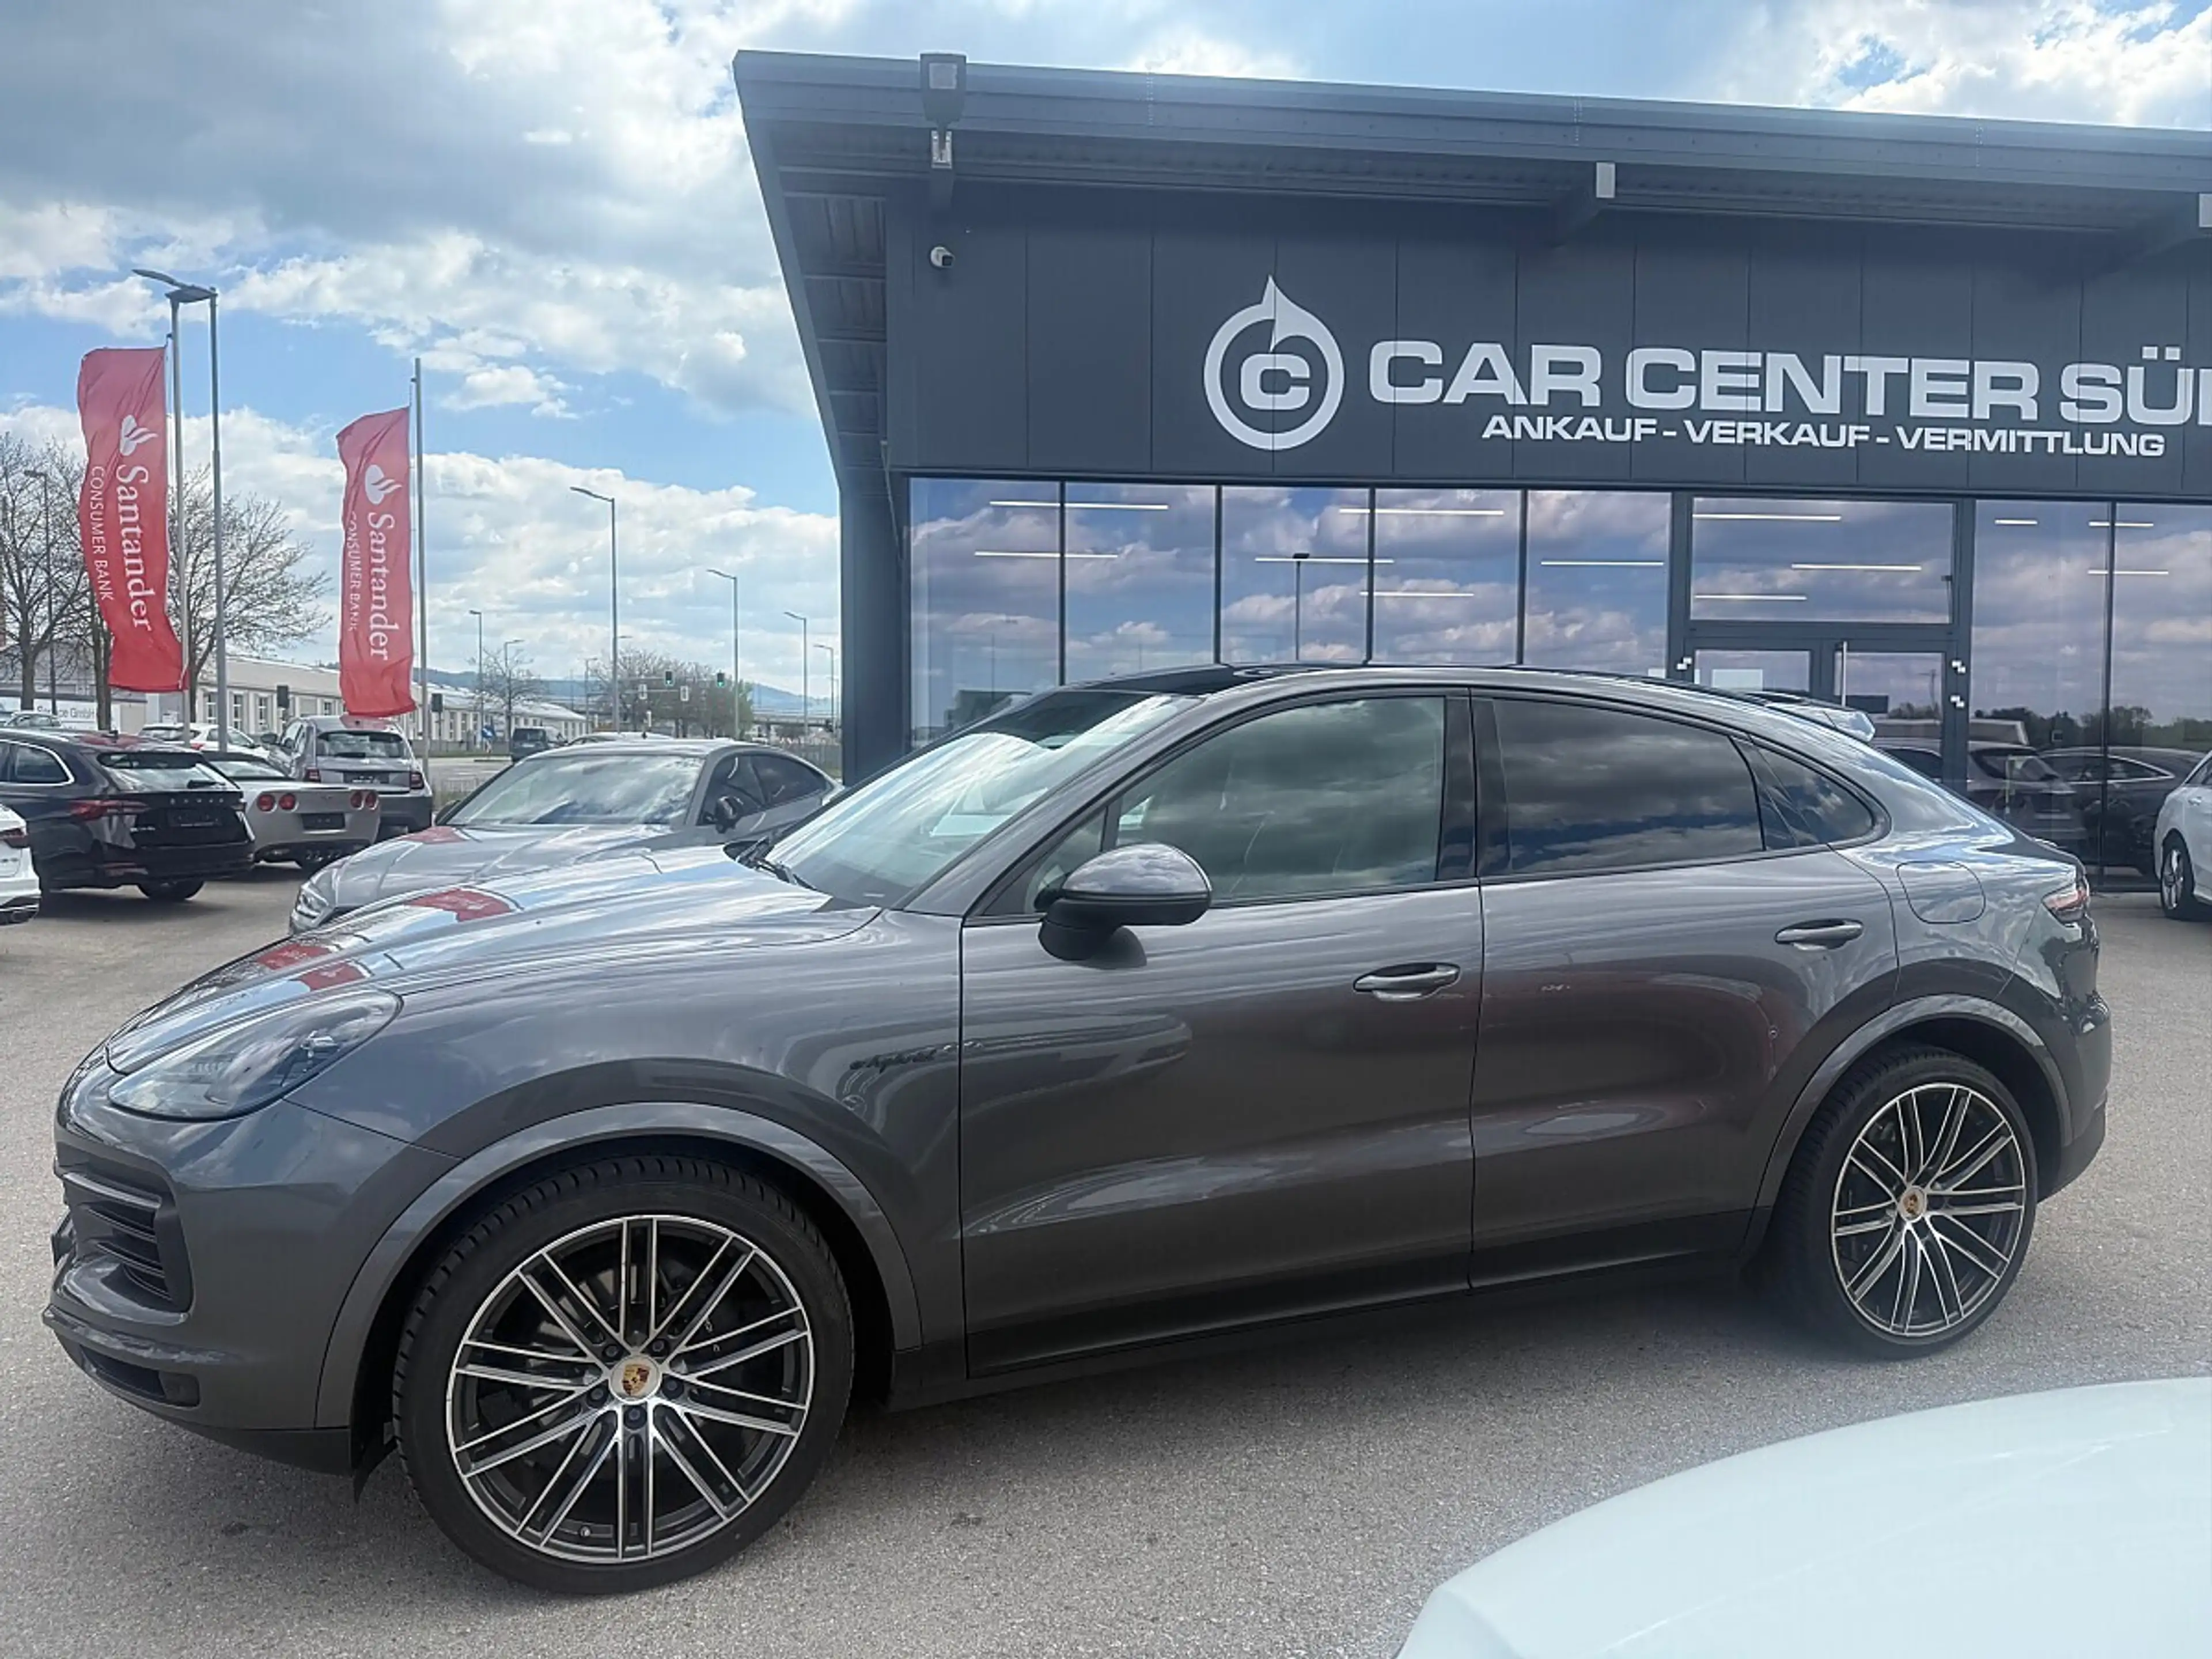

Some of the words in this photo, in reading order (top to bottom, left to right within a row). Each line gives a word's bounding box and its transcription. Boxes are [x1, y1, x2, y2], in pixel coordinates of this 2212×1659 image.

[1370, 340, 1602, 407] CAR
[1624, 347, 2040, 421] CENTER
[2059, 346, 2212, 426] SÜ
[1482, 415, 1657, 442] ANKAUF
[1683, 420, 1870, 448] VERKAUF
[1895, 426, 2165, 457] VERMITTLUNG
[90, 465, 107, 554] CONSUMER
[116, 464, 155, 631] Santander
[94, 560, 114, 601] BANK
[368, 512, 399, 661] Santander
